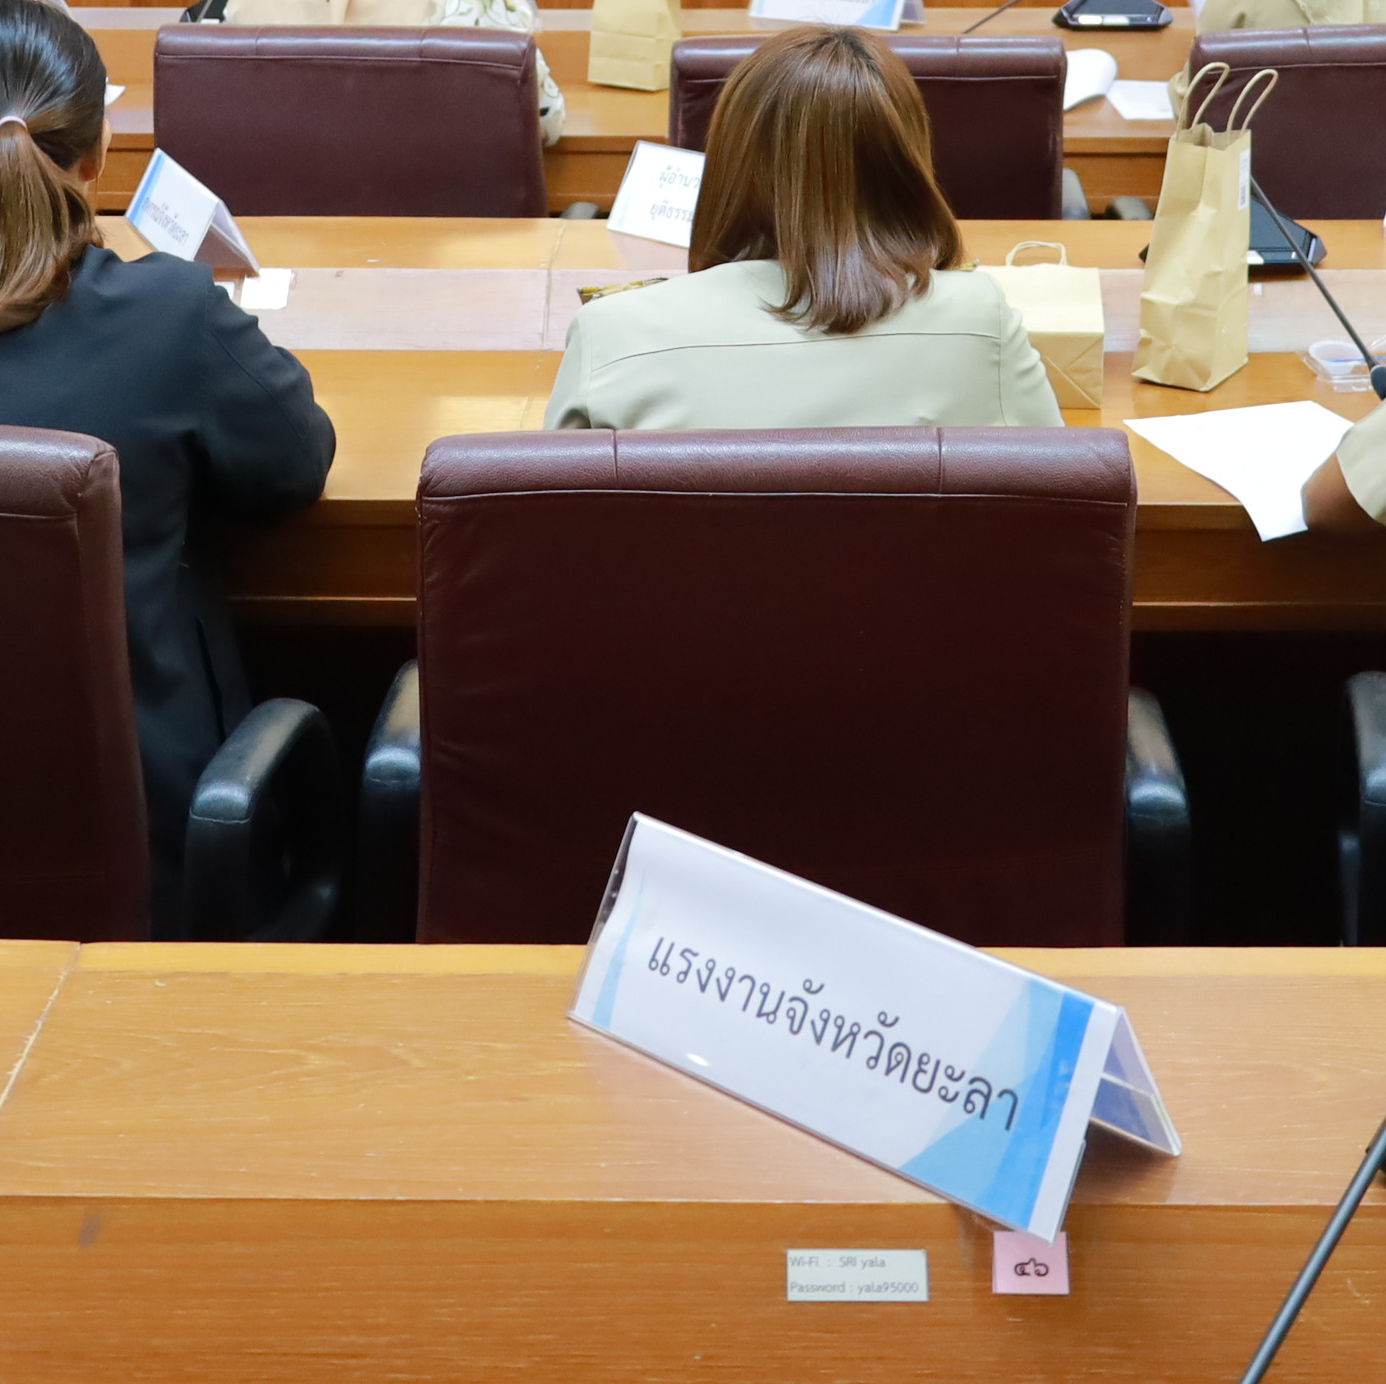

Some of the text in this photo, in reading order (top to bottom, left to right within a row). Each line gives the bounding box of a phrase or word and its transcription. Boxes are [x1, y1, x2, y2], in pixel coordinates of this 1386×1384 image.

[647, 936, 1020, 1131] แรงงานจังหวัดยะลา
[790, 1256, 819, 1267] Wi-Fi
[839, 1256, 857, 1267] SRI
[862, 1256, 886, 1270] yala
[790, 1282, 846, 1294] Password
[857, 1281, 919, 1296] yala95000
